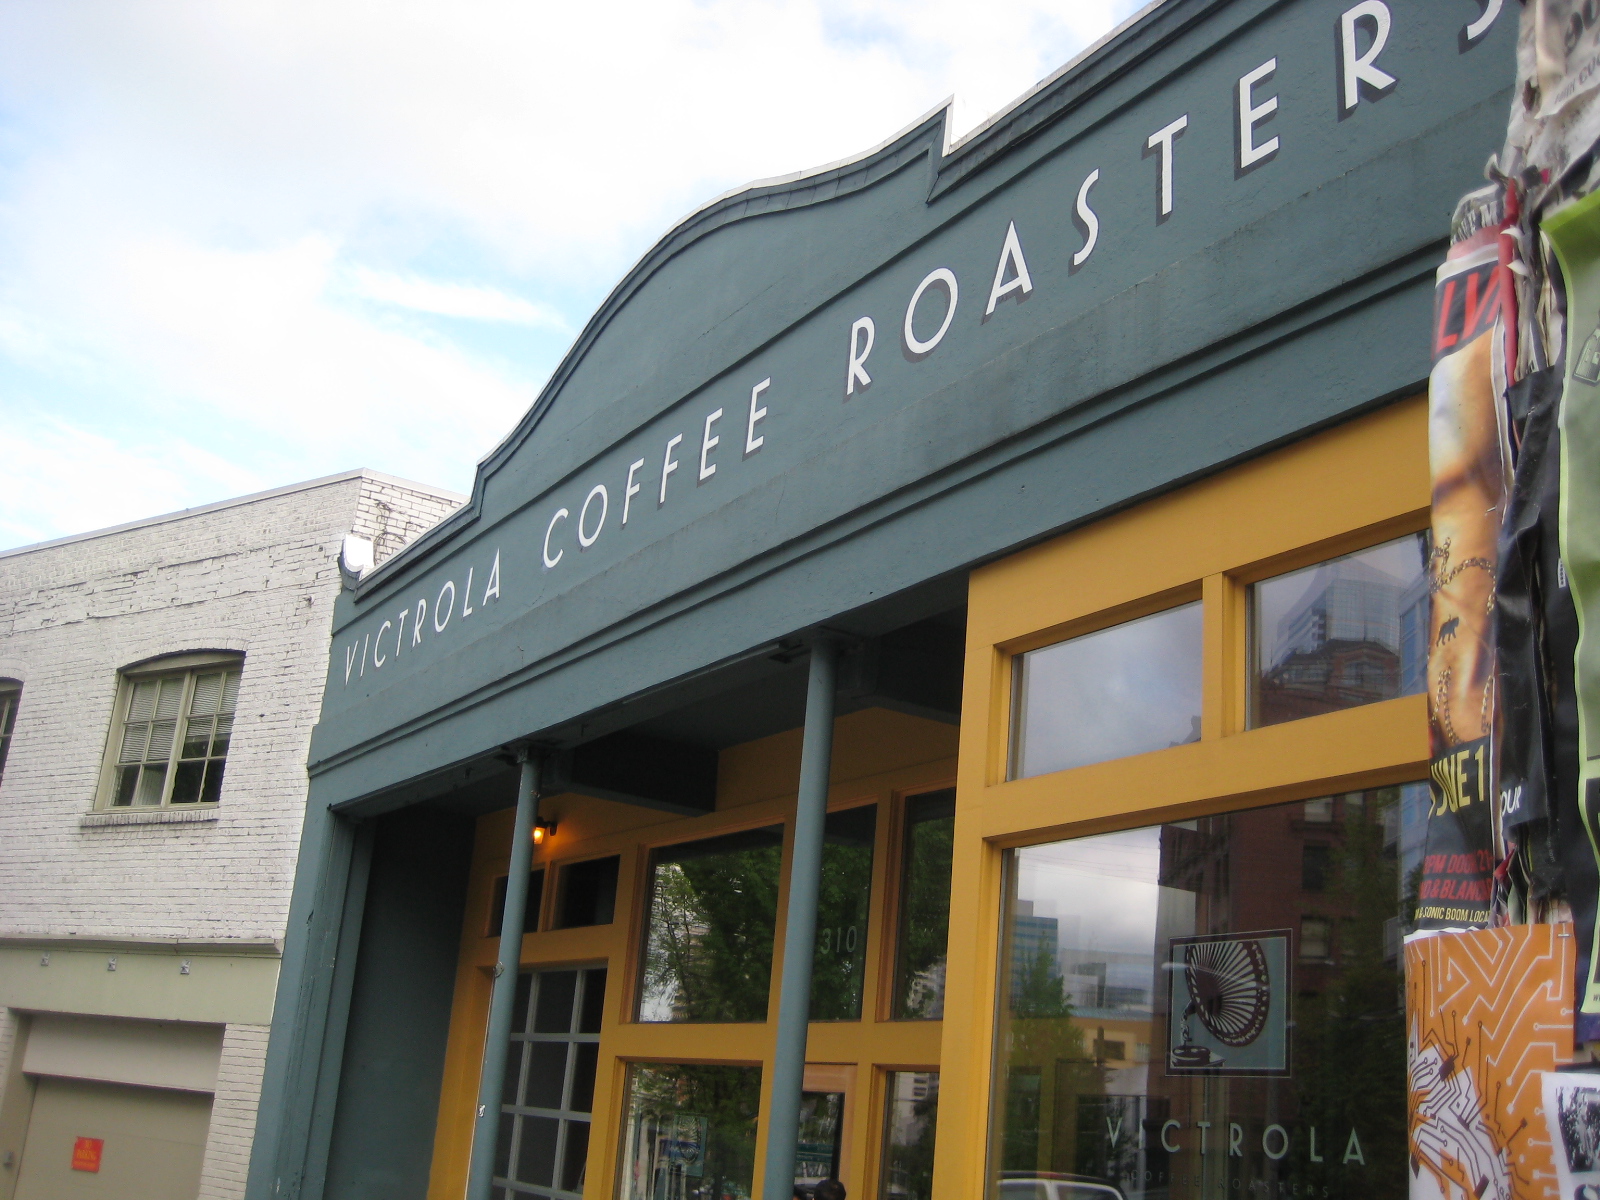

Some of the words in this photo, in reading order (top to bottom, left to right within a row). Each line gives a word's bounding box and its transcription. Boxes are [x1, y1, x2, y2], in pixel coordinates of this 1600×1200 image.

[345, 548, 501, 685] VICTROLA
[542, 376, 771, 569] COFFEE
[1475, 745, 1485, 802] 1
[1445, 907, 1468, 922] BOOM
[820, 925, 858, 955] 310
[1106, 1116, 1366, 1166] VICTROLA
